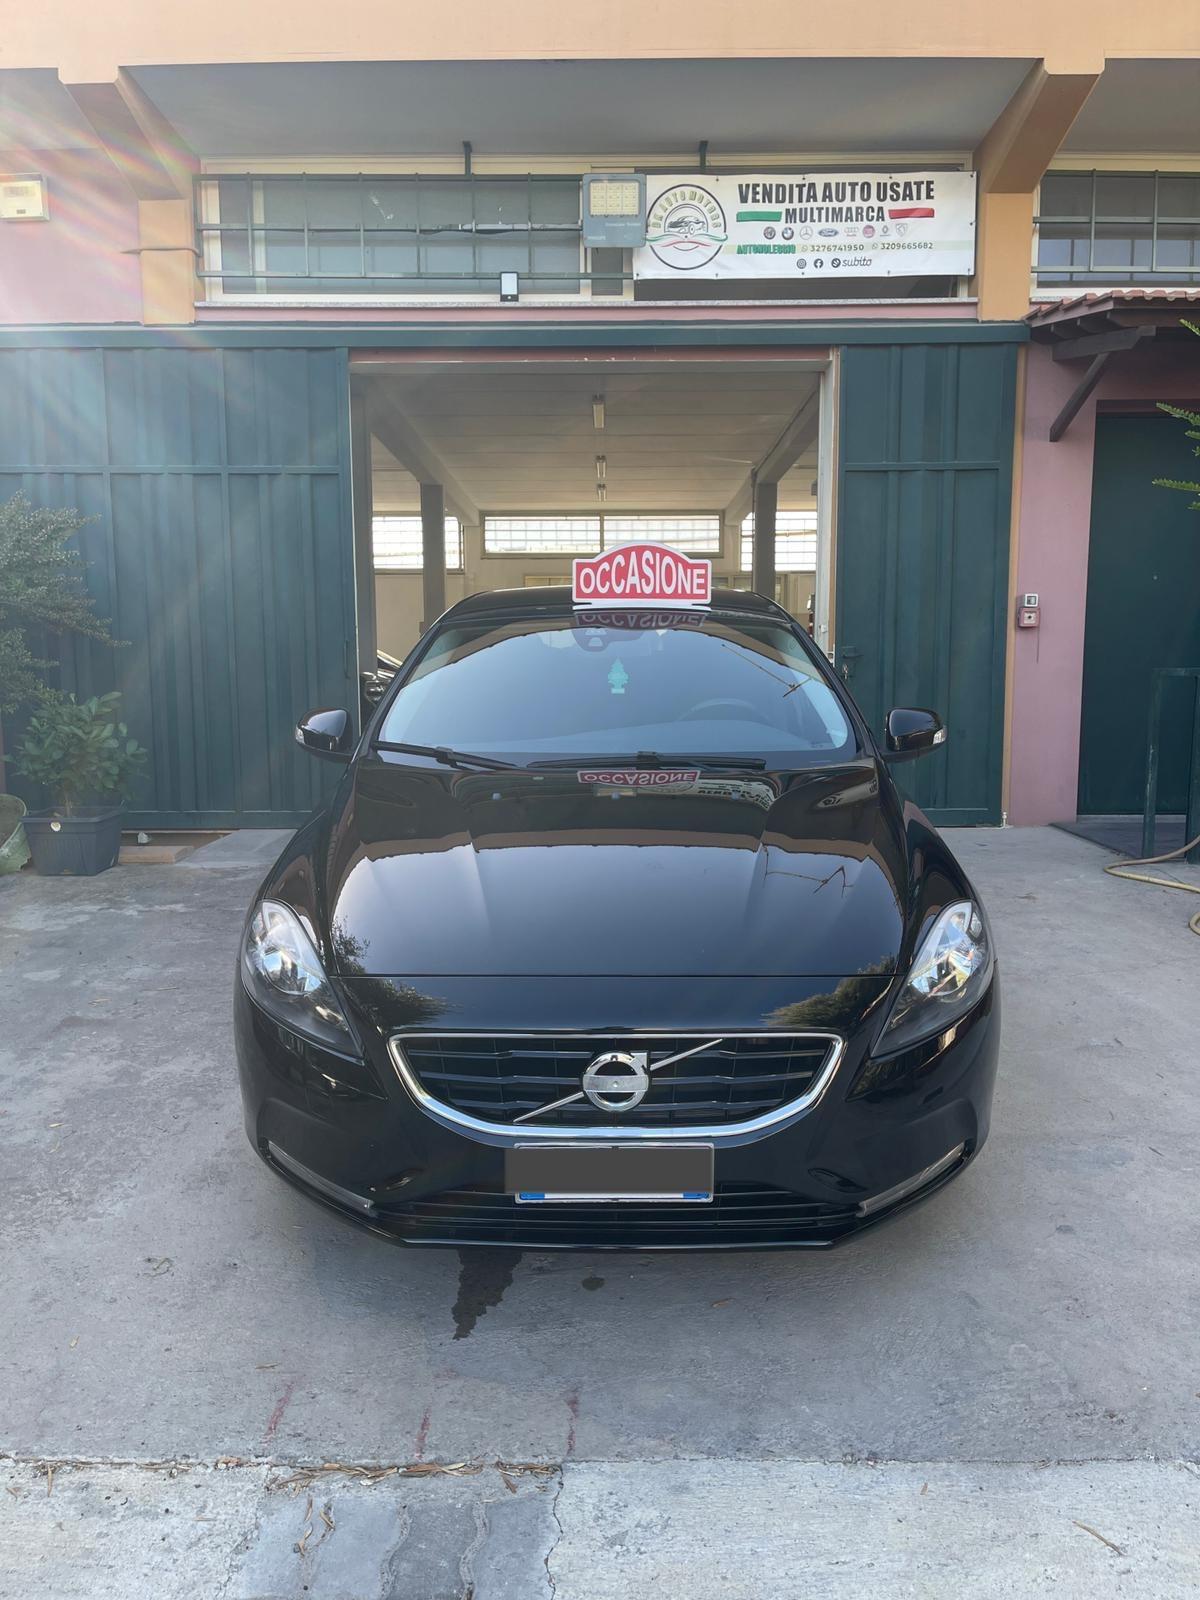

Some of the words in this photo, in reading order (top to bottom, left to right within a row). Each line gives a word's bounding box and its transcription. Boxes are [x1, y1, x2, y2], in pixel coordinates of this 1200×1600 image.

[737, 182, 818, 204] VENDITA
[821, 181, 872, 203] AUTO
[876, 180, 935, 202] USATE
[785, 205, 885, 224] MULTIMARCA
[810, 243, 865, 253] 3276741950
[880, 241, 934, 251] 3209665682
[842, 255, 872, 267] subito
[579, 550, 706, 595] OCCASIONE
